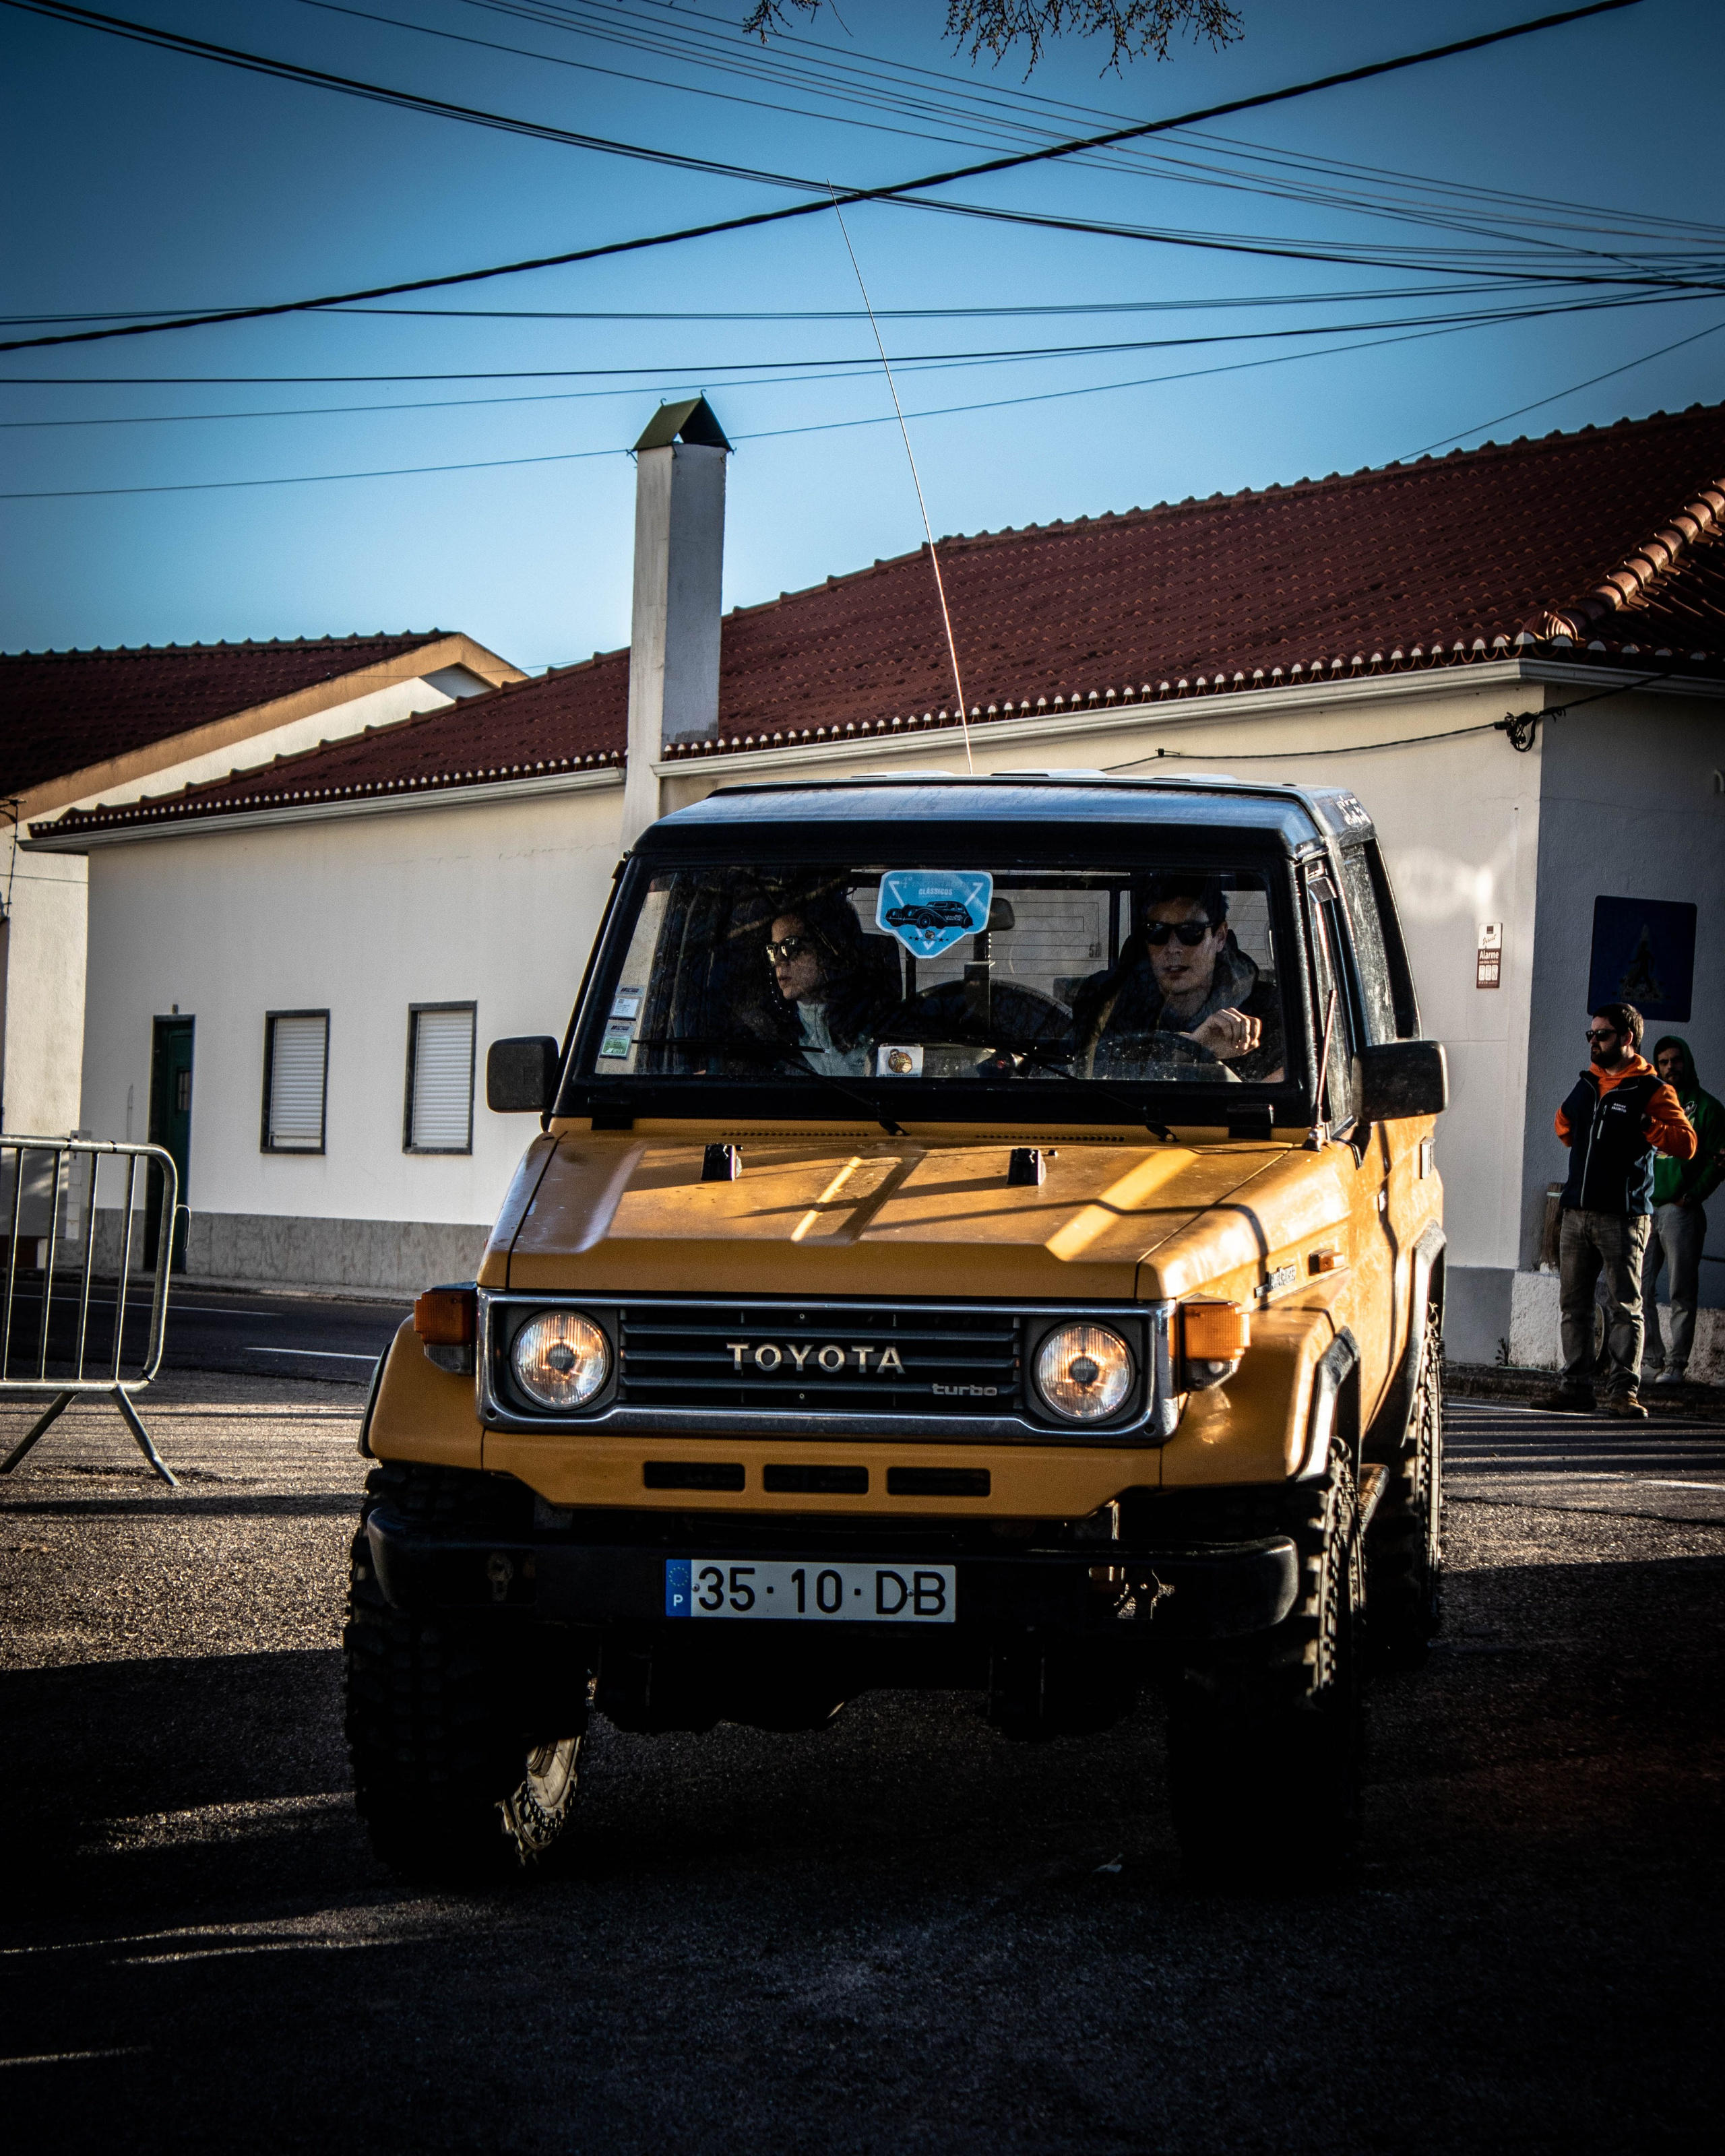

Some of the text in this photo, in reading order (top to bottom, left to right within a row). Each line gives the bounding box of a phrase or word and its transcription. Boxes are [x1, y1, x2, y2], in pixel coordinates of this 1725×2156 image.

[918, 887, 953, 896] CLÁSSICOS
[1479, 949, 1499, 959] Alarme
[726, 1343, 906, 1374] TOYOTA
[932, 1383, 998, 1397] turbo
[673, 1594, 683, 1607] P
